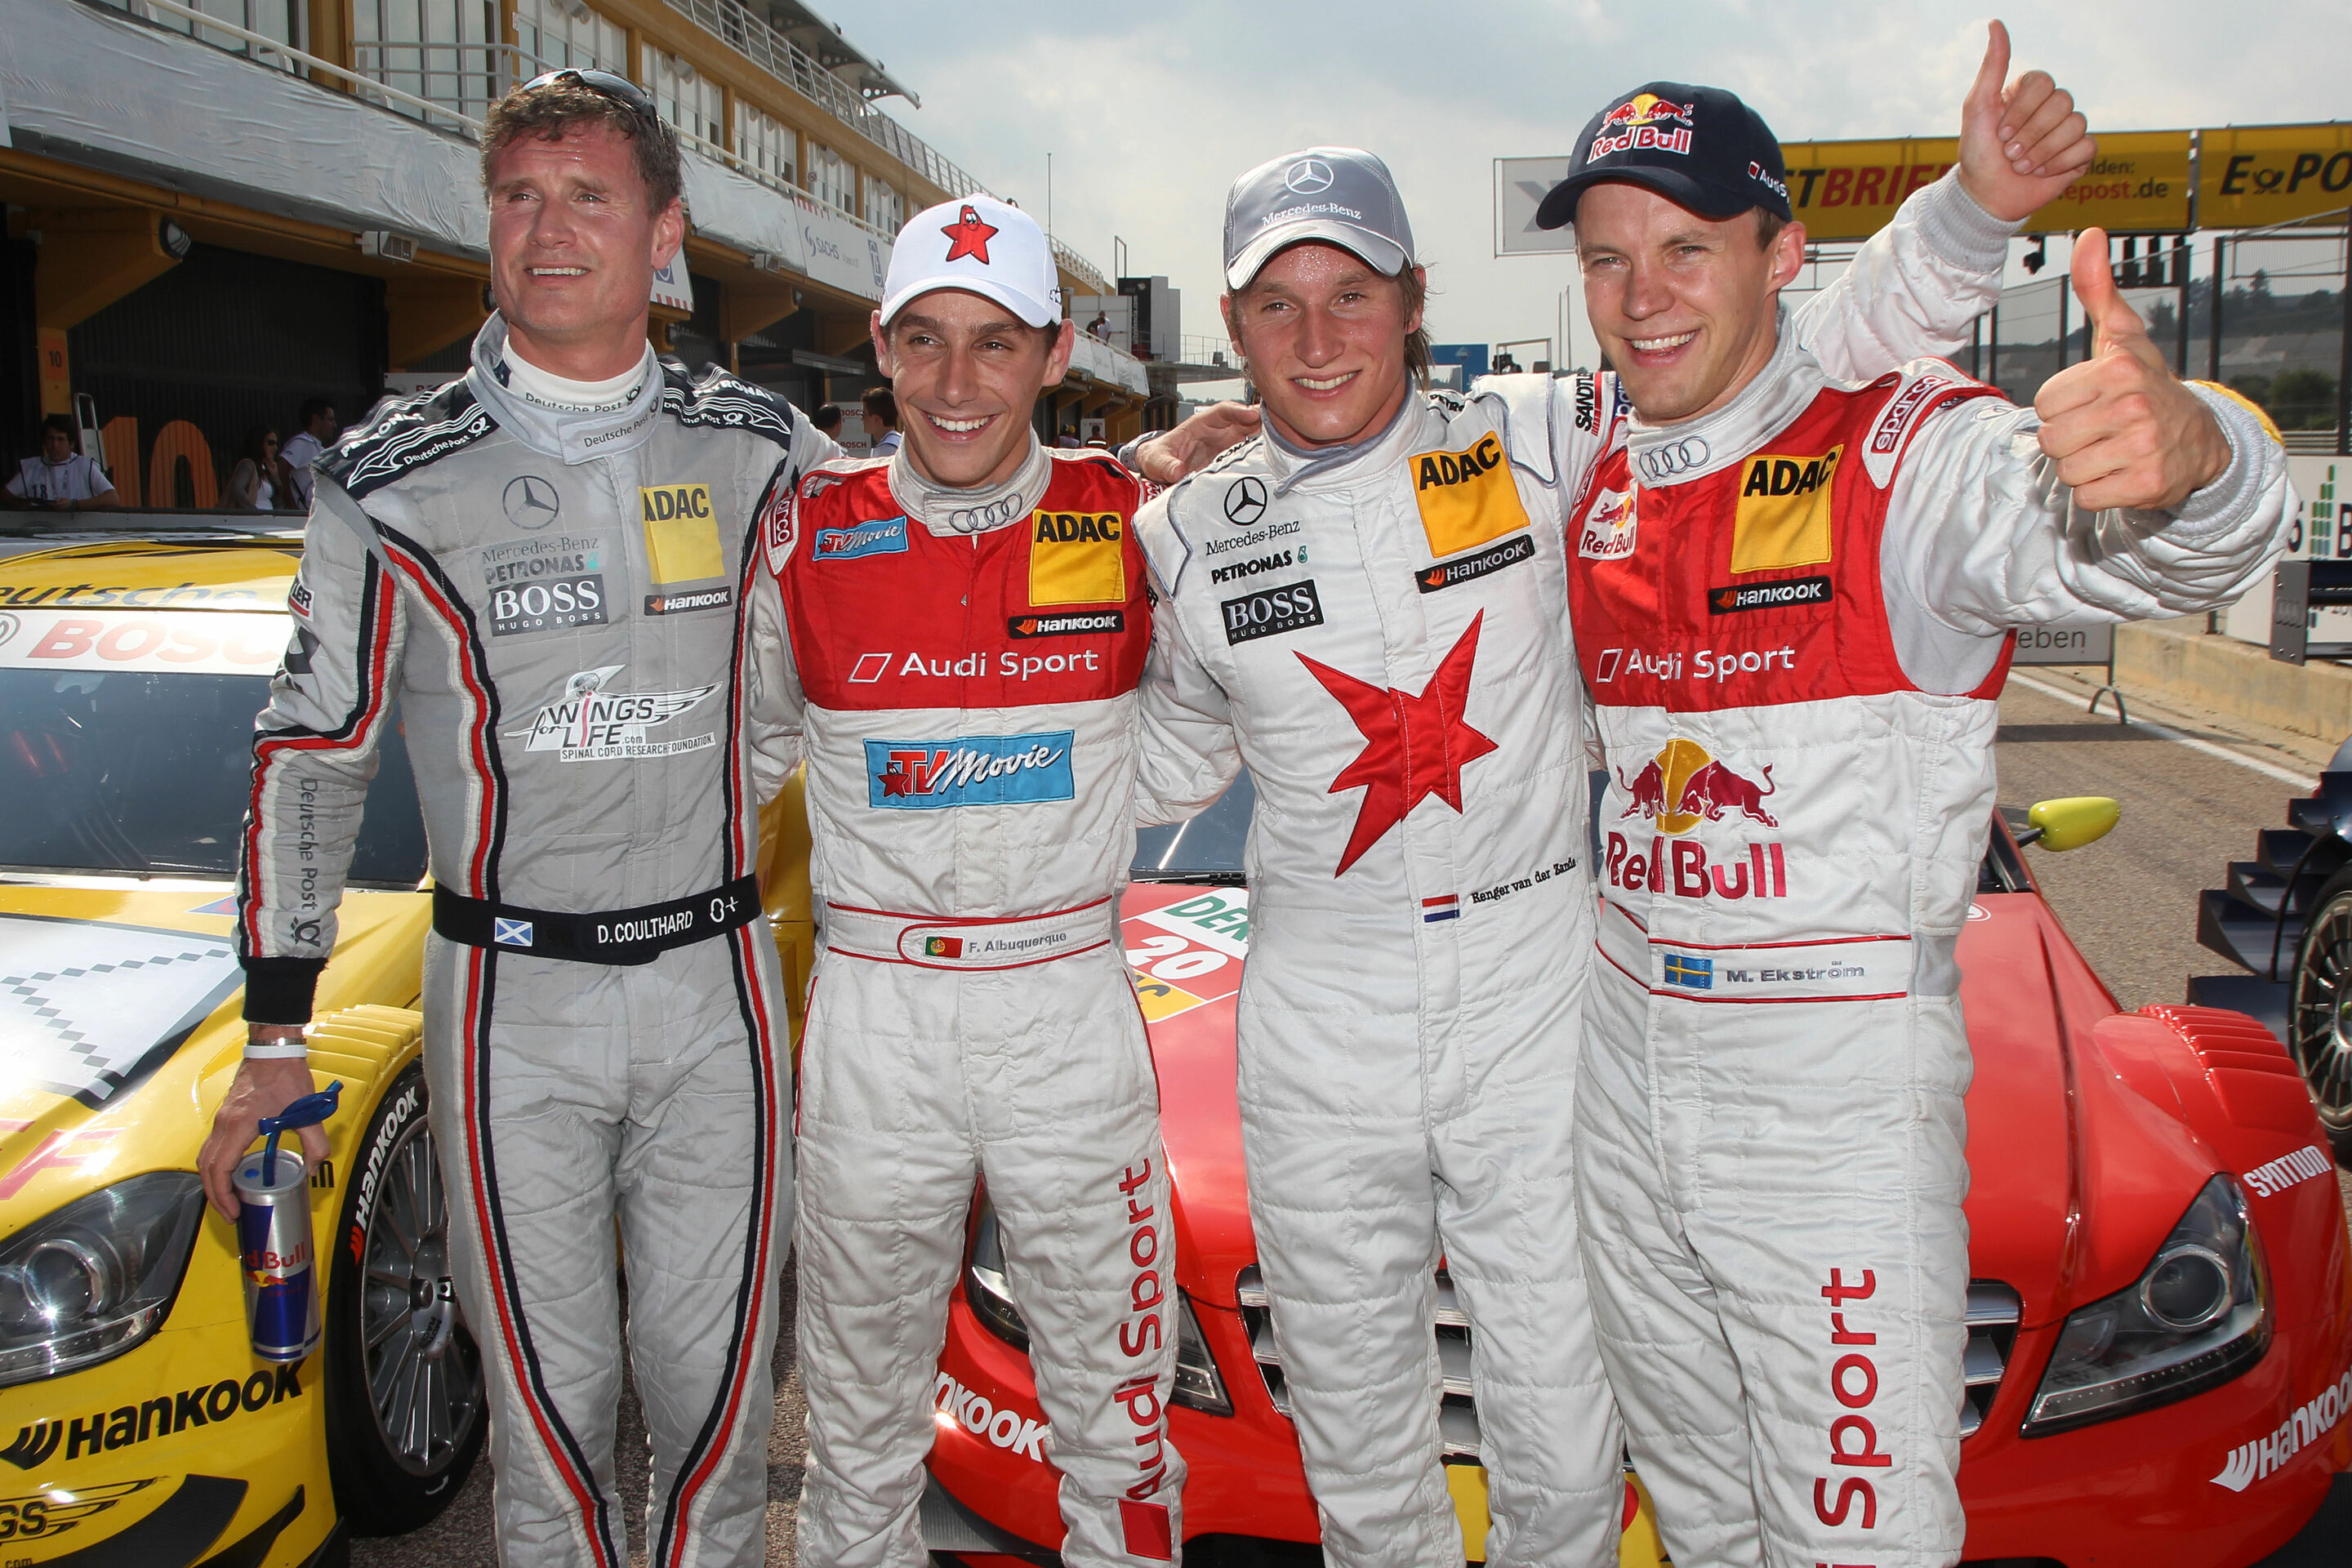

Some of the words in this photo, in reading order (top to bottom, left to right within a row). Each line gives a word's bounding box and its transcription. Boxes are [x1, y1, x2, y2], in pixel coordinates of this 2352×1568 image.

[1588, 126, 1634, 164] Red
[1633, 126, 1692, 155] Bull
[1261, 203, 1362, 228] Mercedes-Benz
[817, 237, 840, 260] SACHS
[48, 350, 63, 368] 10
[525, 392, 589, 412] Deutsche
[594, 401, 622, 412] Post
[700, 412, 720, 425] Post
[1575, 372, 1594, 432] SANDTL
[583, 425, 633, 448] Deutsche
[633, 413, 649, 430] Post
[101, 416, 217, 509] 10
[403, 439, 449, 466] Deutsche
[448, 434, 471, 448] Post
[1419, 439, 1501, 491] ADAC
[1743, 451, 1837, 497] ADAC
[1036, 514, 1121, 544] ADAC
[1205, 519, 1301, 556] Mercedes-Benz
[1581, 529, 1618, 555] Red
[482, 536, 599, 564] Mercedes-Benz
[1210, 548, 1294, 585] PETRONAS
[484, 554, 586, 585] PETRONAS
[495, 579, 600, 621] BOSS
[1225, 584, 1316, 630] BOSS
[498, 618, 544, 631] HUGO
[556, 612, 601, 624] BOSS
[1231, 624, 1267, 639] HUGO
[1276, 614, 1317, 628] BOSS
[2015, 627, 2087, 648] eben
[26, 619, 283, 666] BOSC
[899, 652, 987, 677] Audi
[1000, 649, 1099, 681] Sport
[1624, 648, 1682, 681] Audi
[1693, 645, 1796, 684] Sport
[528, 709, 562, 750] for
[561, 747, 595, 760] SPINAL
[597, 746, 623, 758] CORD
[625, 742, 668, 756] RESEARCH
[890, 749, 951, 795] TV
[926, 744, 1063, 793] Movie
[298, 778, 319, 861] Deutsche
[1471, 884, 1510, 904] Renger
[1511, 877, 1533, 892] van
[1535, 869, 1551, 884] der
[1553, 857, 1577, 876] Zande
[1606, 831, 1664, 894] Red
[1673, 839, 1788, 900] Bull
[301, 867, 319, 911] Post
[969, 942, 981, 954] F.
[984, 933, 1067, 952] Albuquerque
[1125, 935, 1229, 980] 20
[1726, 969, 1754, 982] M.
[1760, 960, 1864, 982] Ekström
[263, 1241, 306, 1269] Bull
[1119, 1159, 1165, 1357] Sport
[1814, 1267, 1892, 1530] Sport
[1114, 1373, 1169, 1501] Audi
